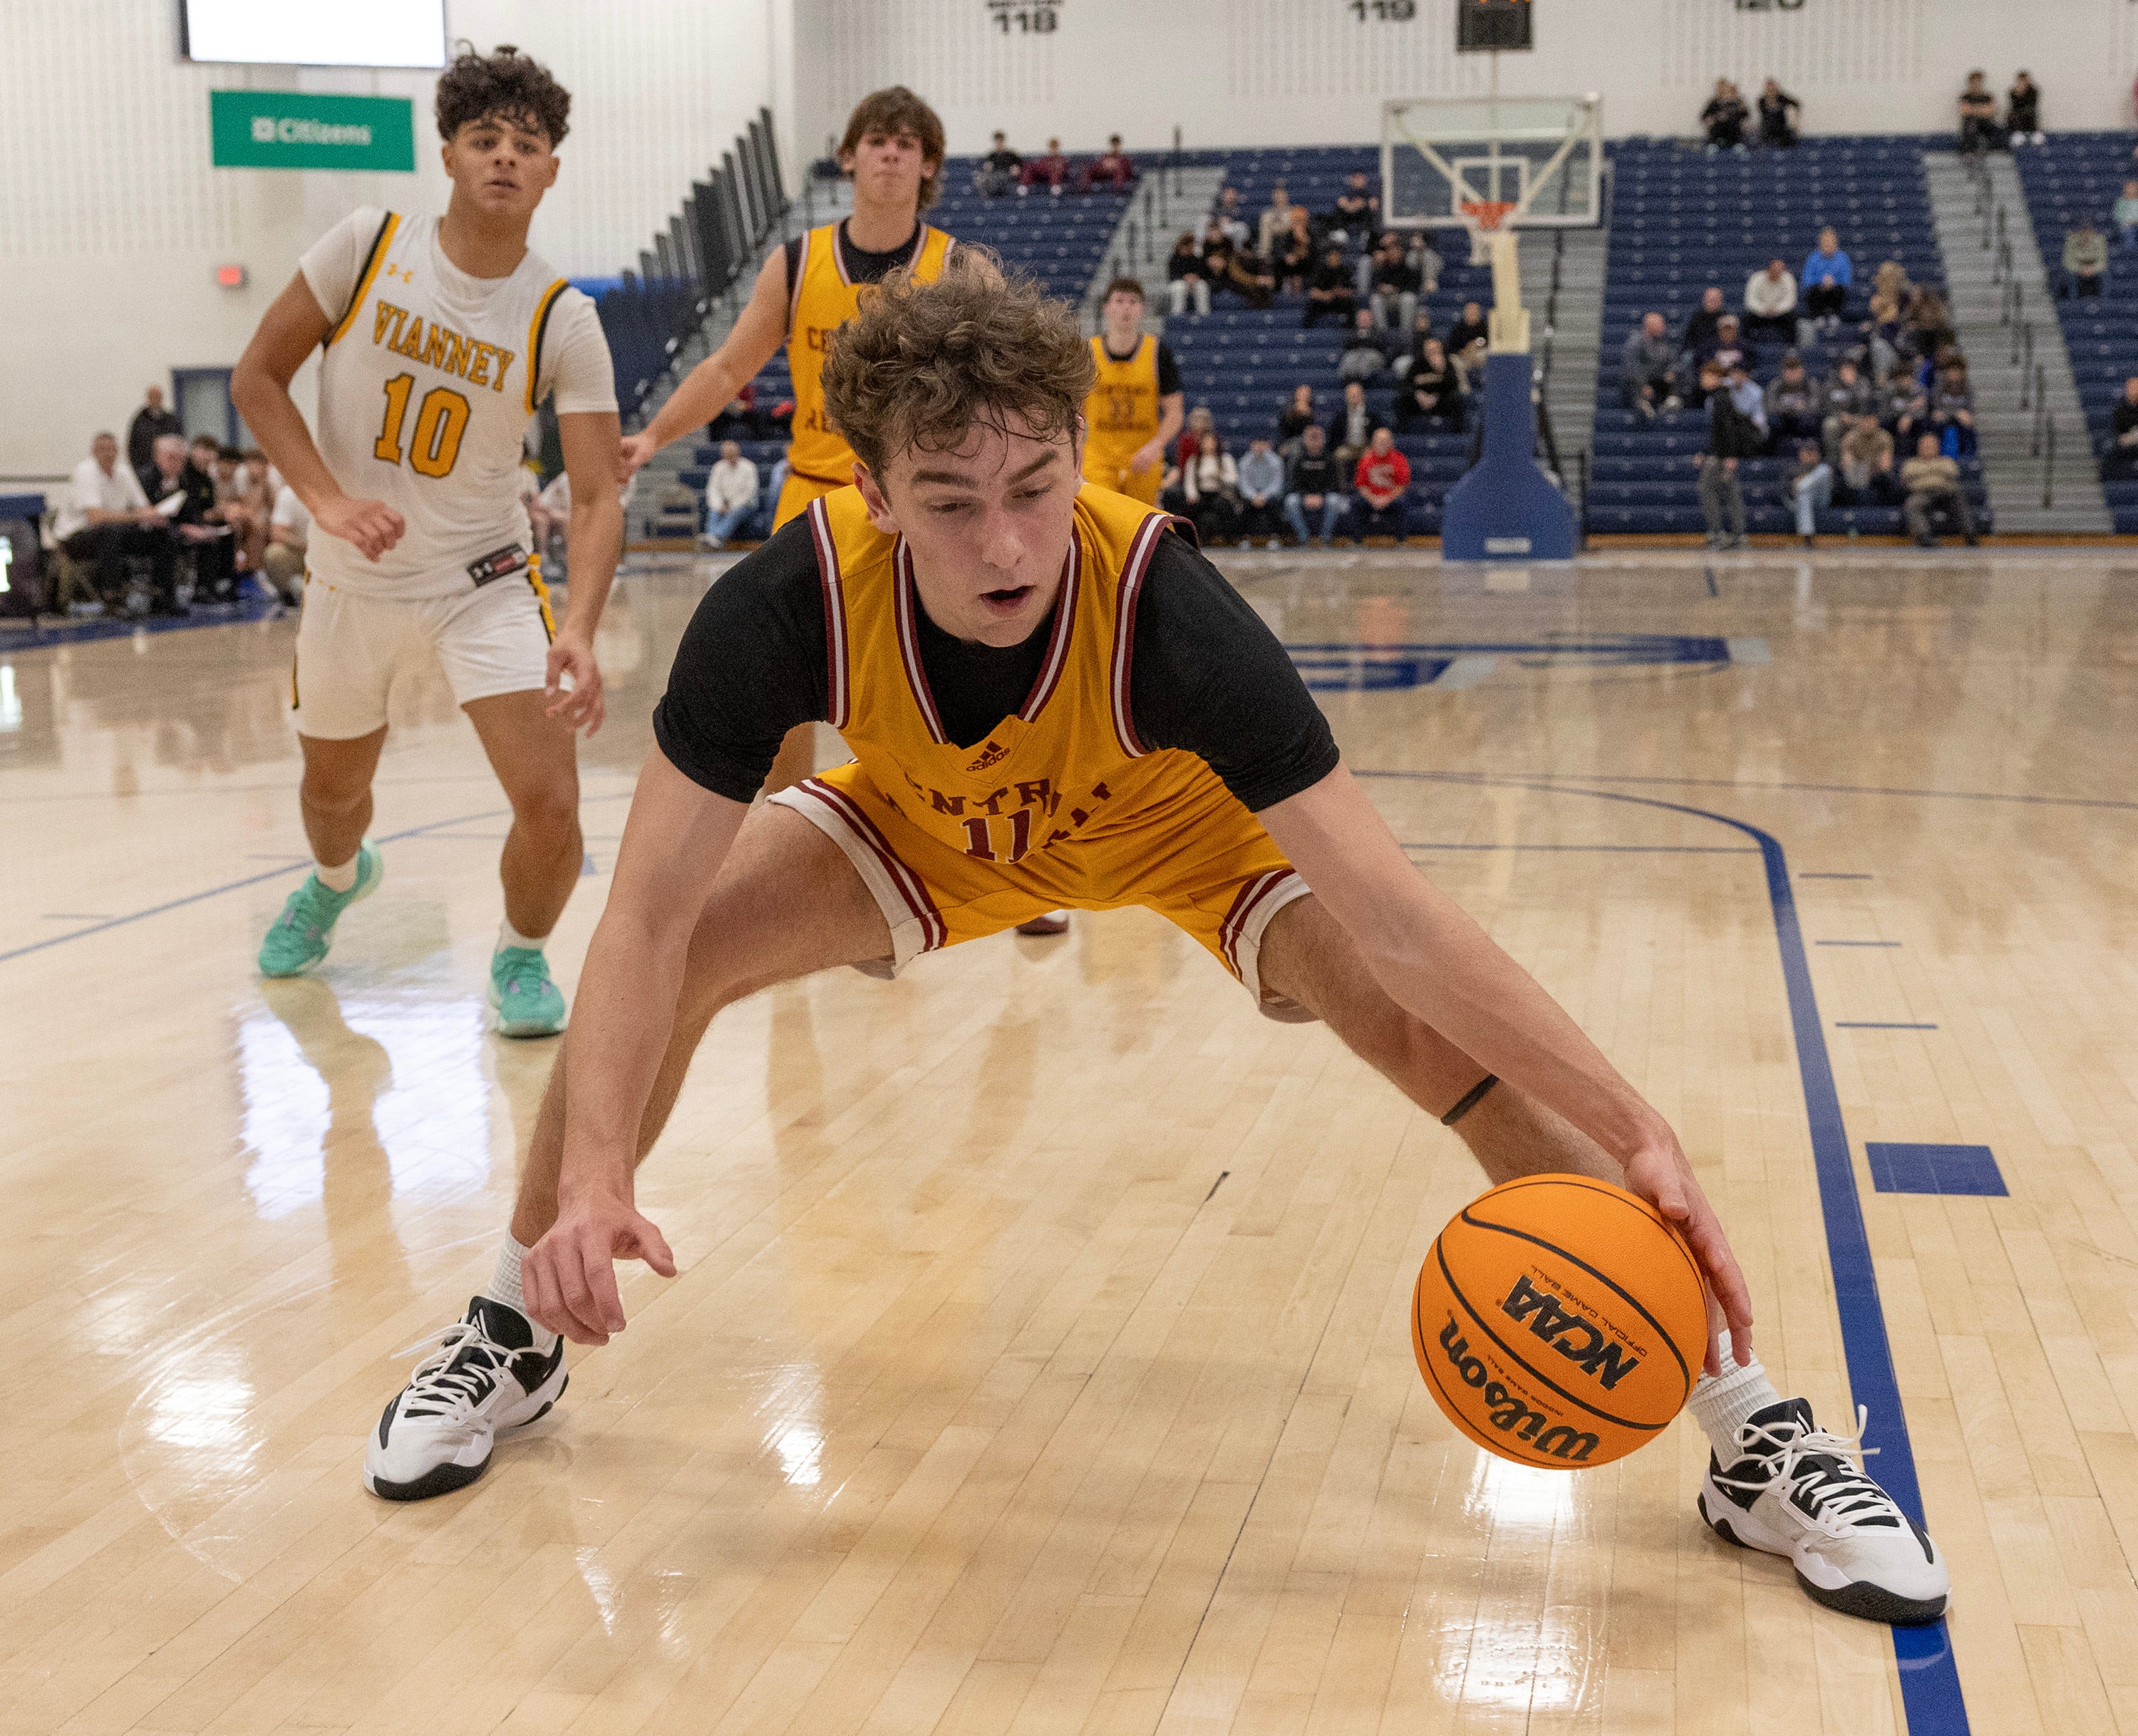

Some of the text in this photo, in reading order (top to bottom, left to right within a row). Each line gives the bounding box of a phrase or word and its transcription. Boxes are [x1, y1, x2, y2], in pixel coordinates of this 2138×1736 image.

[278, 117, 372, 145] Citizens
[373, 299, 515, 392] VIANNEY
[373, 372, 471, 478] 10
[966, 748, 1011, 771] adidas
[960, 808, 1032, 864] 11
[1501, 1274, 1640, 1390] NCAA
[1531, 1265, 1648, 1357] OFFICIAL GAME BALL
[1439, 1316, 1600, 1461] Wilson
[1505, 1375, 1528, 1395] GAME
